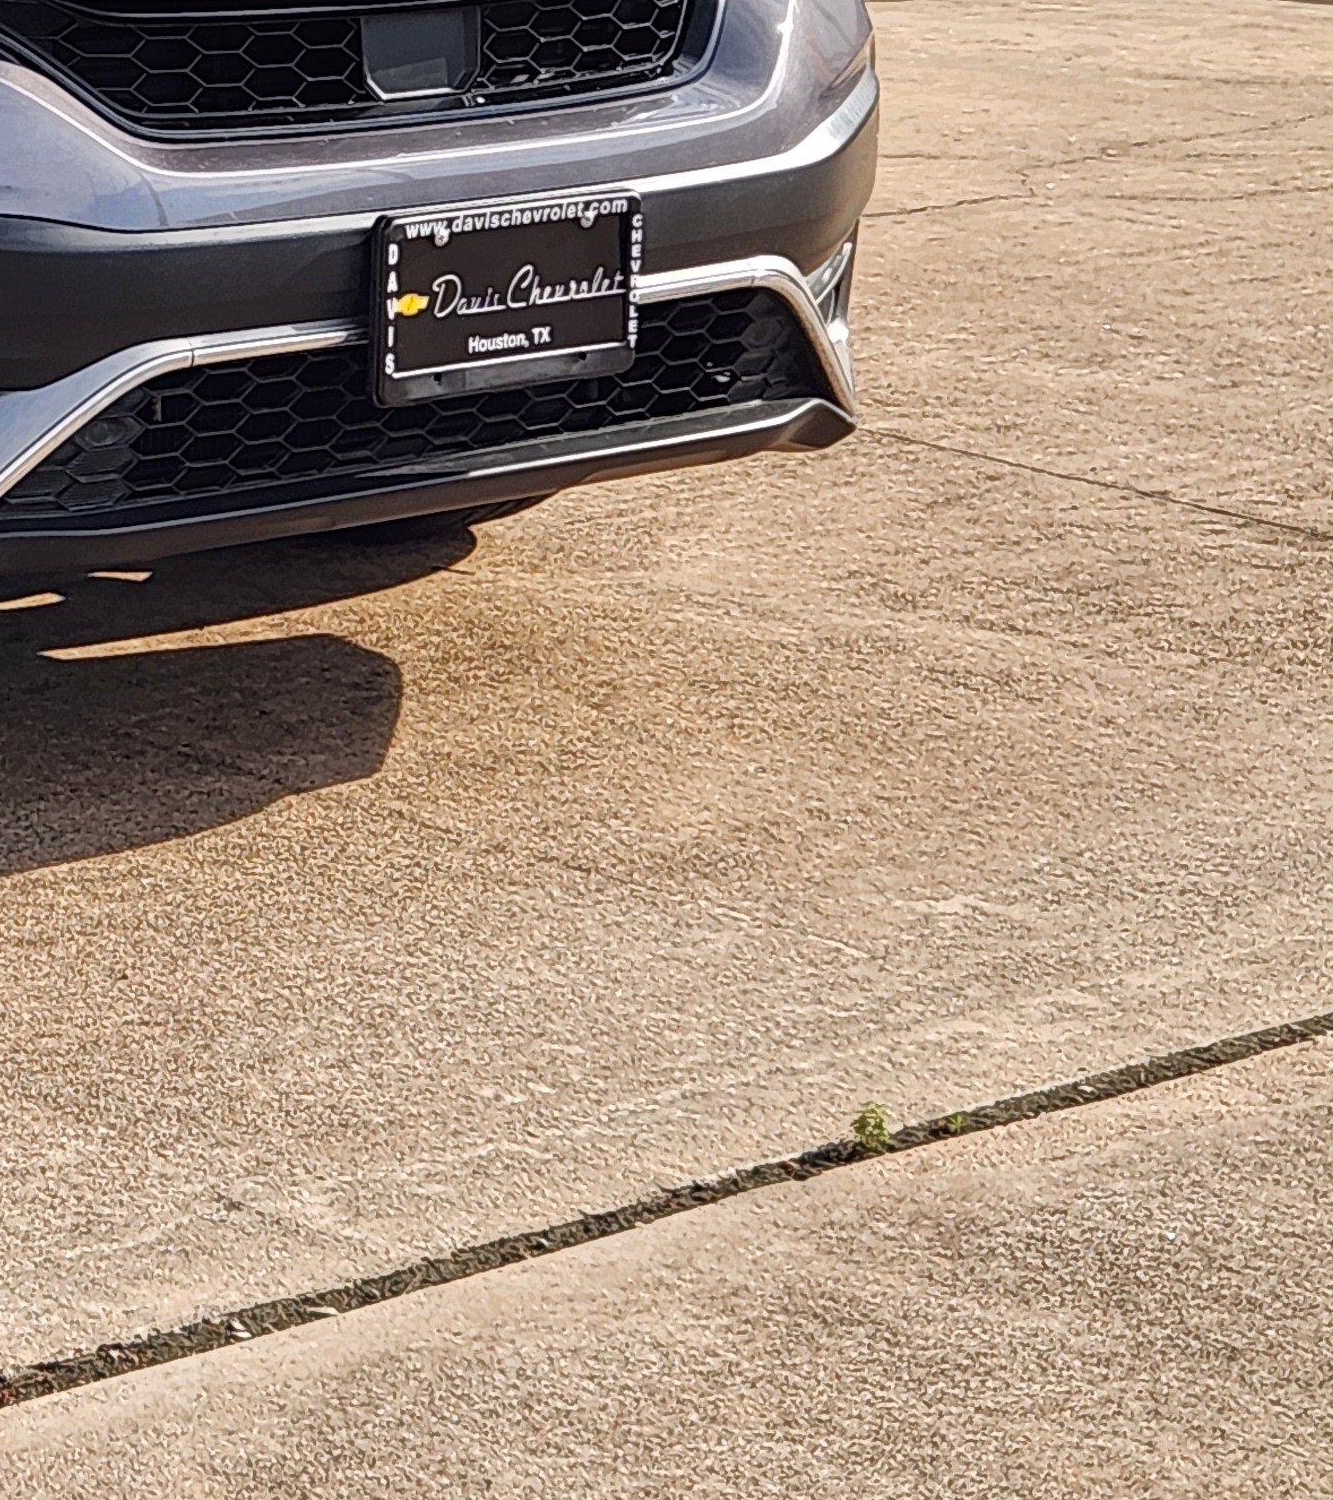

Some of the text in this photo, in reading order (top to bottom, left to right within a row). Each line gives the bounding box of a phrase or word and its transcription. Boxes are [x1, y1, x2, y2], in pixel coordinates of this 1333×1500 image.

[404, 198, 629, 240] www.davischevrolet.com
[432, 264, 627, 318] Davis Chevrolet
[627, 213, 644, 349] CHEVROLET
[384, 243, 400, 375] DAVIS
[467, 326, 552, 354] Houston, TX
